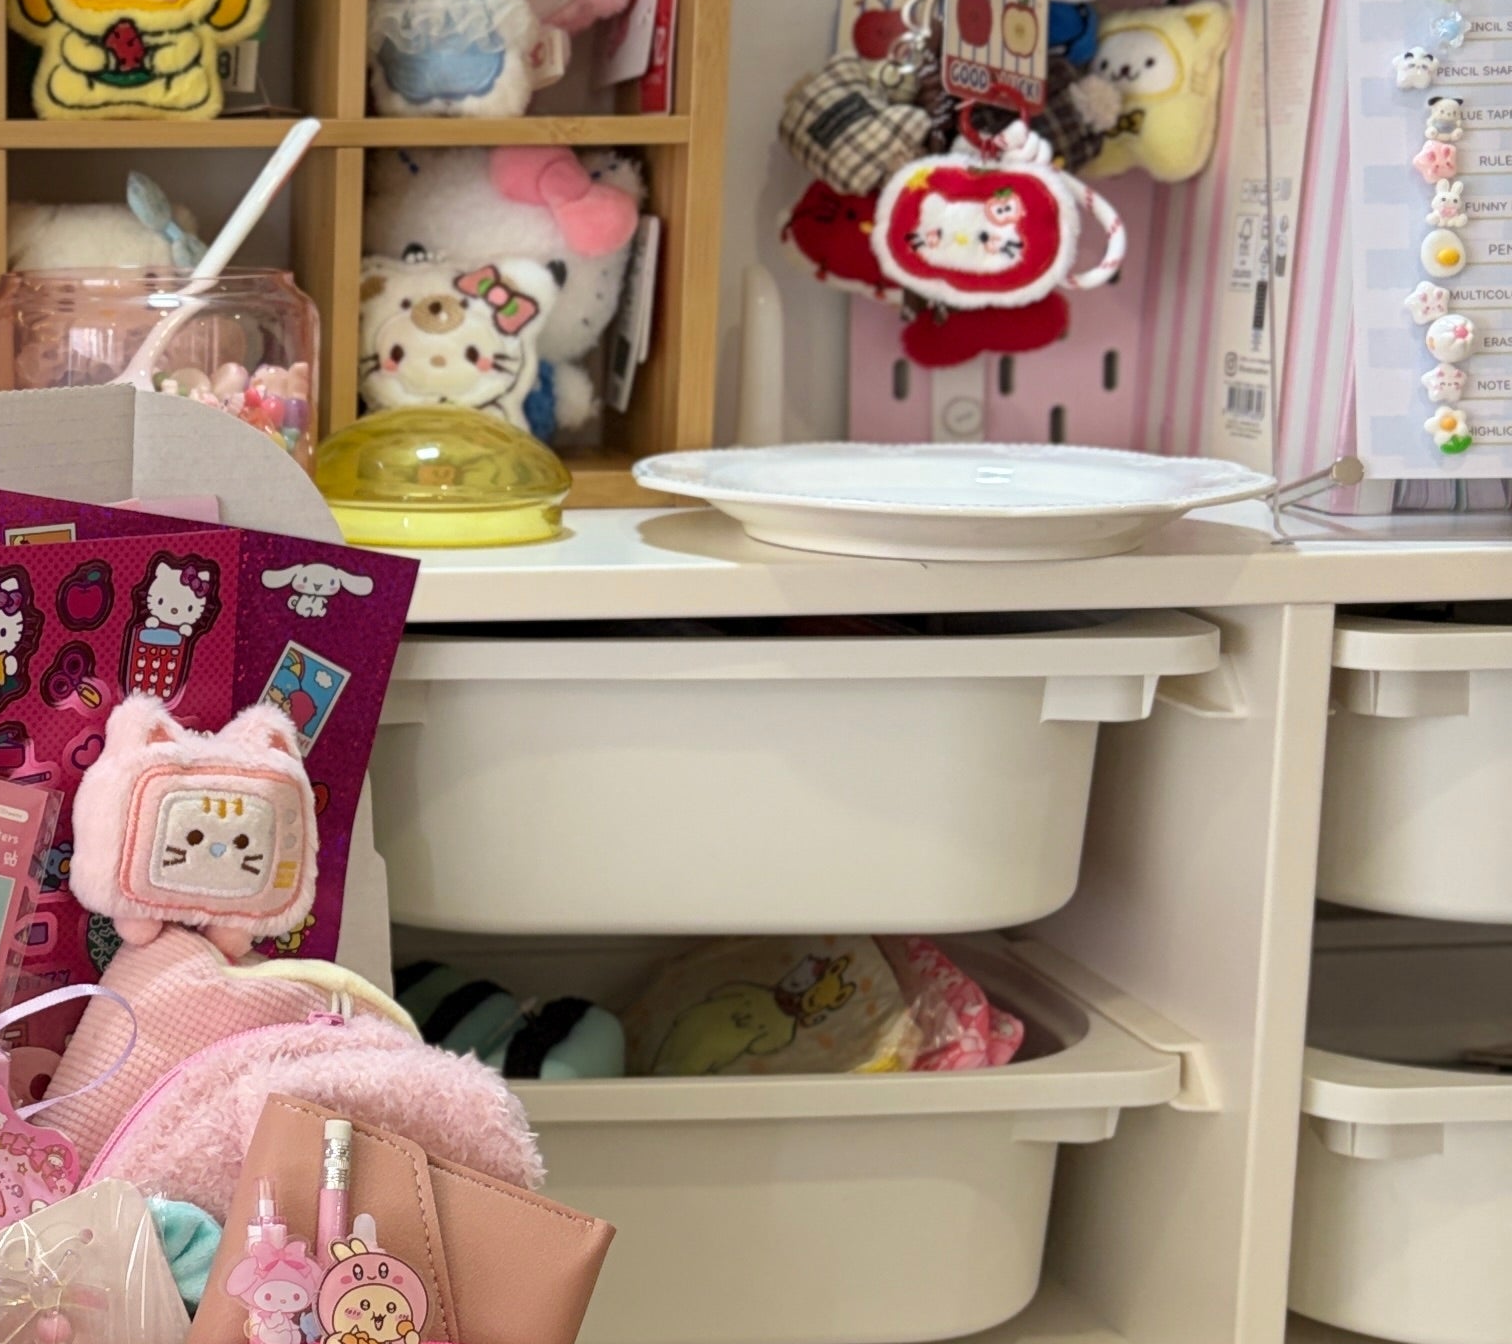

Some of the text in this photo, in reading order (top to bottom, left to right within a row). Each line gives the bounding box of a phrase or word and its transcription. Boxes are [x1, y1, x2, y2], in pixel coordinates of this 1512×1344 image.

[951, 61, 989, 90] GOOD
[1437, 66, 1479, 77] PENCIL
[1464, 202, 1508, 213] FUNNY
[1449, 289, 1512, 301] MULTICOL
[1477, 380, 1511, 391] NOTE
